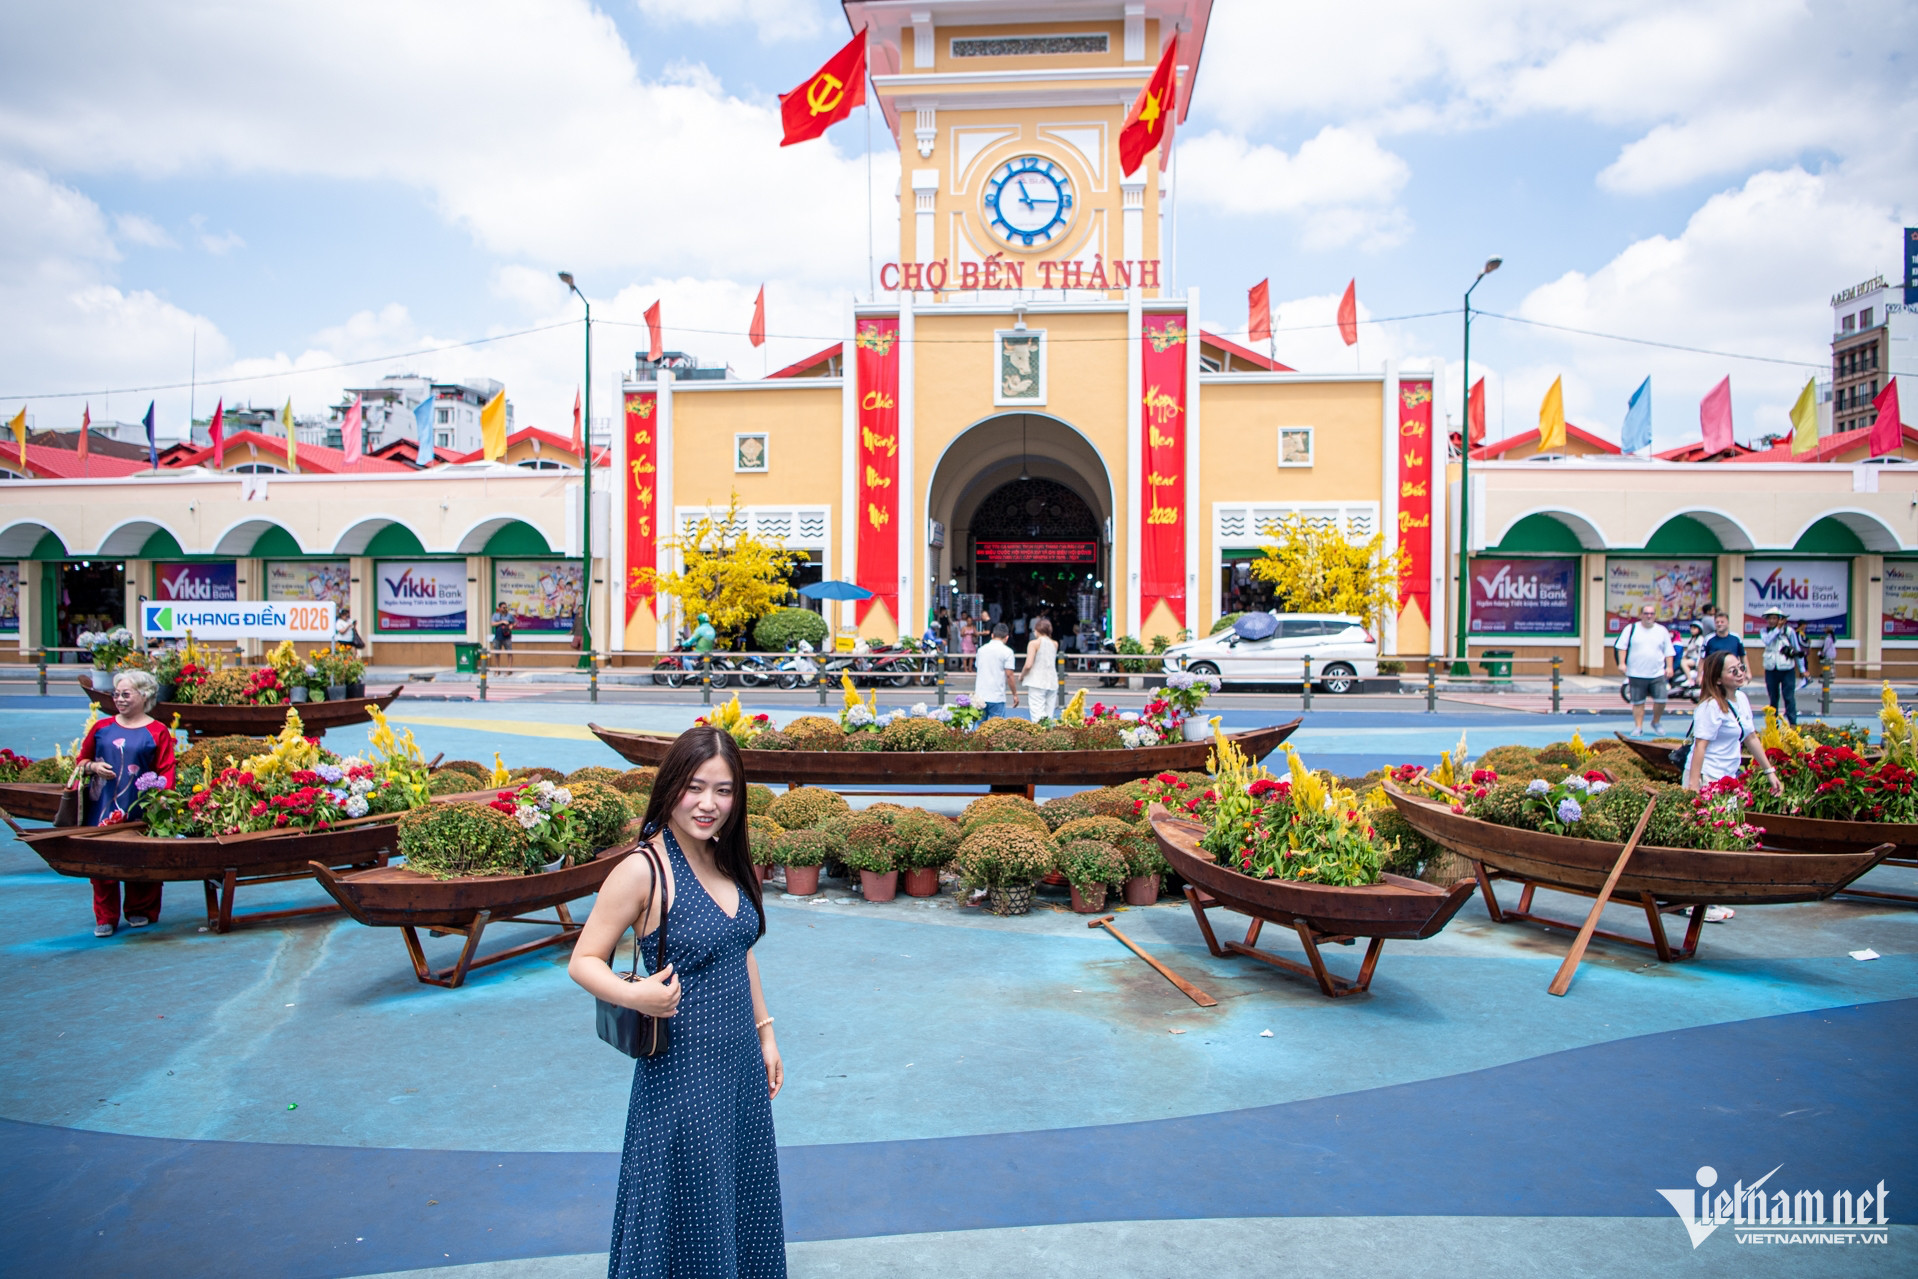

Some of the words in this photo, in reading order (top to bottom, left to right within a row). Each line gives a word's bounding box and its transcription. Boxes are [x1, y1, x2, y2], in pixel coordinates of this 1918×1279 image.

[1020, 157, 1039, 170] 12
[985, 194, 997, 208] 9
[1061, 194, 1072, 208] 3
[1022, 232, 1034, 245] 6
[880, 258, 948, 294] CHỢ
[960, 252, 1025, 289] BẾN
[1038, 253, 1161, 289] THÀNH
[862, 390, 895, 410] Chúc
[1143, 384, 1184, 424] Happy
[862, 426, 898, 457] Mừng
[866, 465, 891, 490] Năm
[1148, 471, 1179, 508] Year
[868, 503, 890, 532] Mới
[1147, 507, 1178, 524] 2026
[162, 568, 211, 599] Vikki
[213, 590, 235, 599] Bank
[384, 567, 436, 598] Vikki
[439, 590, 462, 598] Bank
[1477, 564, 1538, 599] Vikki
[1540, 590, 1567, 599] Bank
[1749, 567, 1809, 600] Vikki
[1812, 592, 1839, 601] Bank
[177, 613, 240, 625] KHANG
[243, 605, 286, 625] ĐIỀN
[289, 608, 329, 631] 2026
